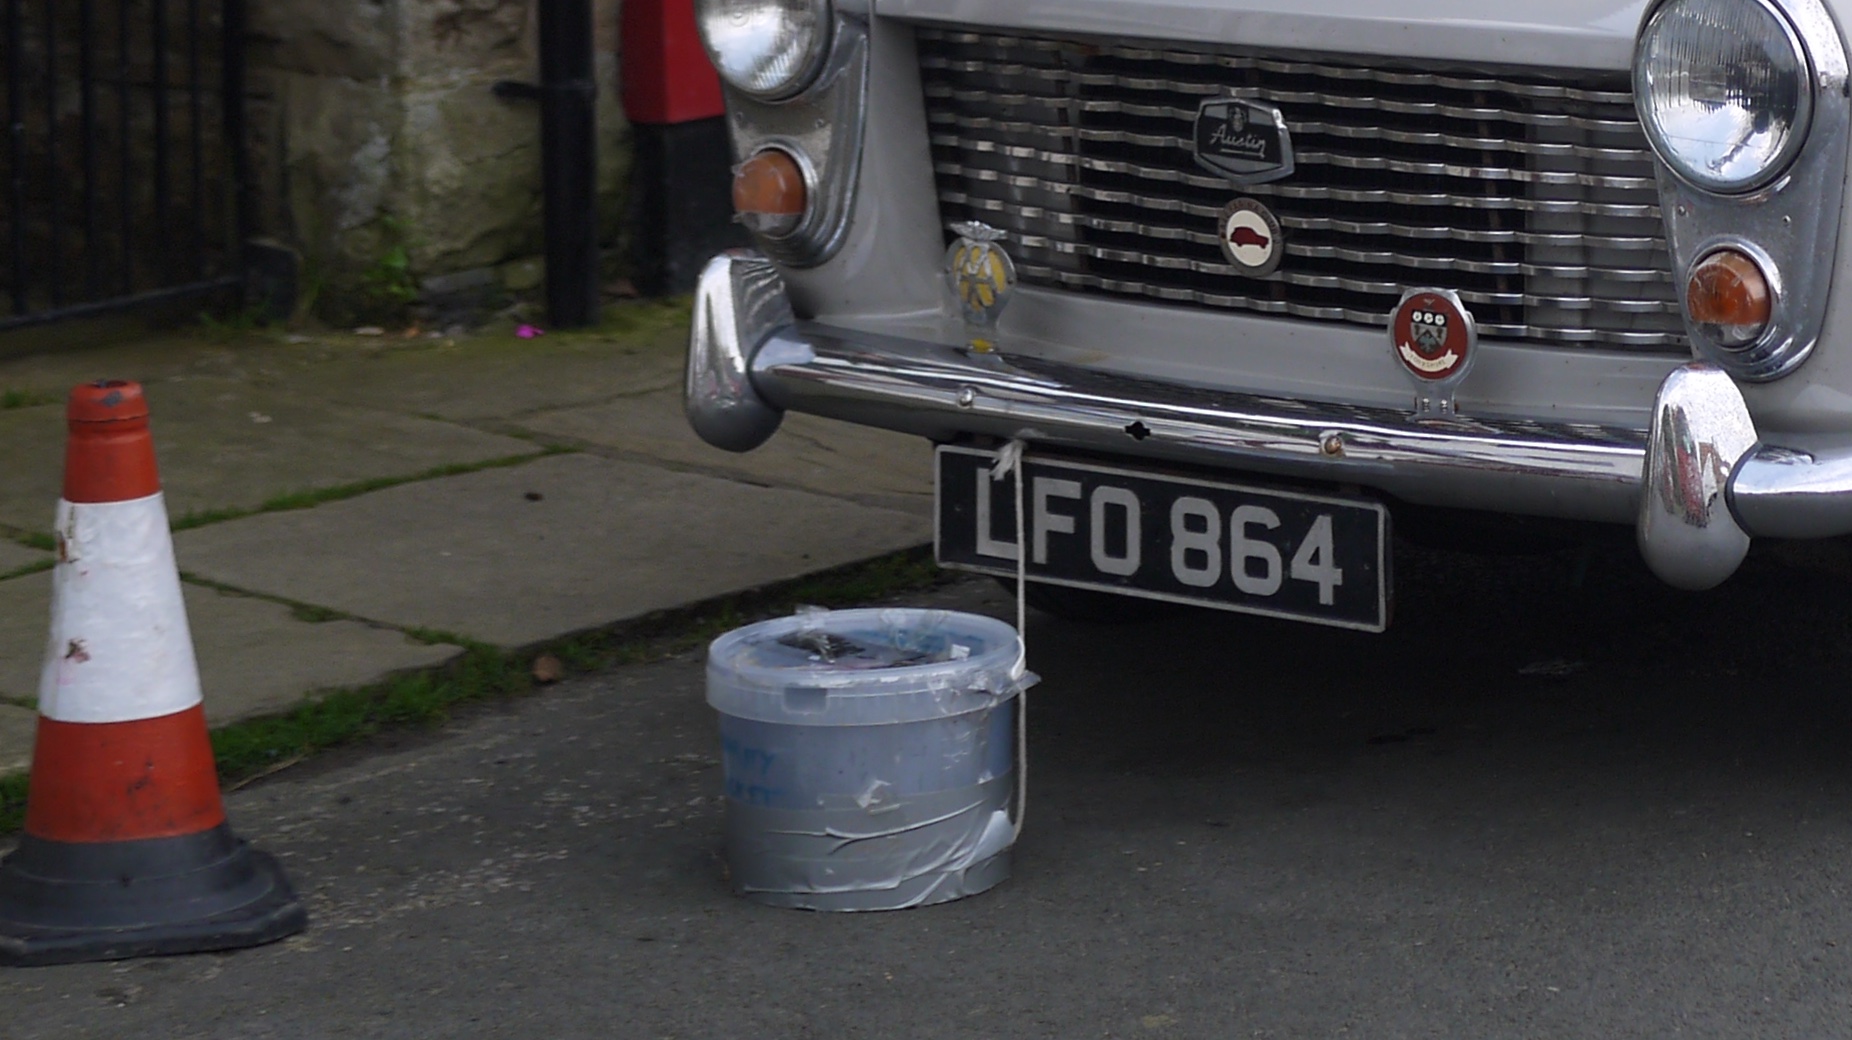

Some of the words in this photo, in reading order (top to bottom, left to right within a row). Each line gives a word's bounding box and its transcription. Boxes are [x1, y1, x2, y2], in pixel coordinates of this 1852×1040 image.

[1210, 123, 1266, 159] Austin
[976, 466, 1142, 577] LFO
[1169, 496, 1343, 606] 864
